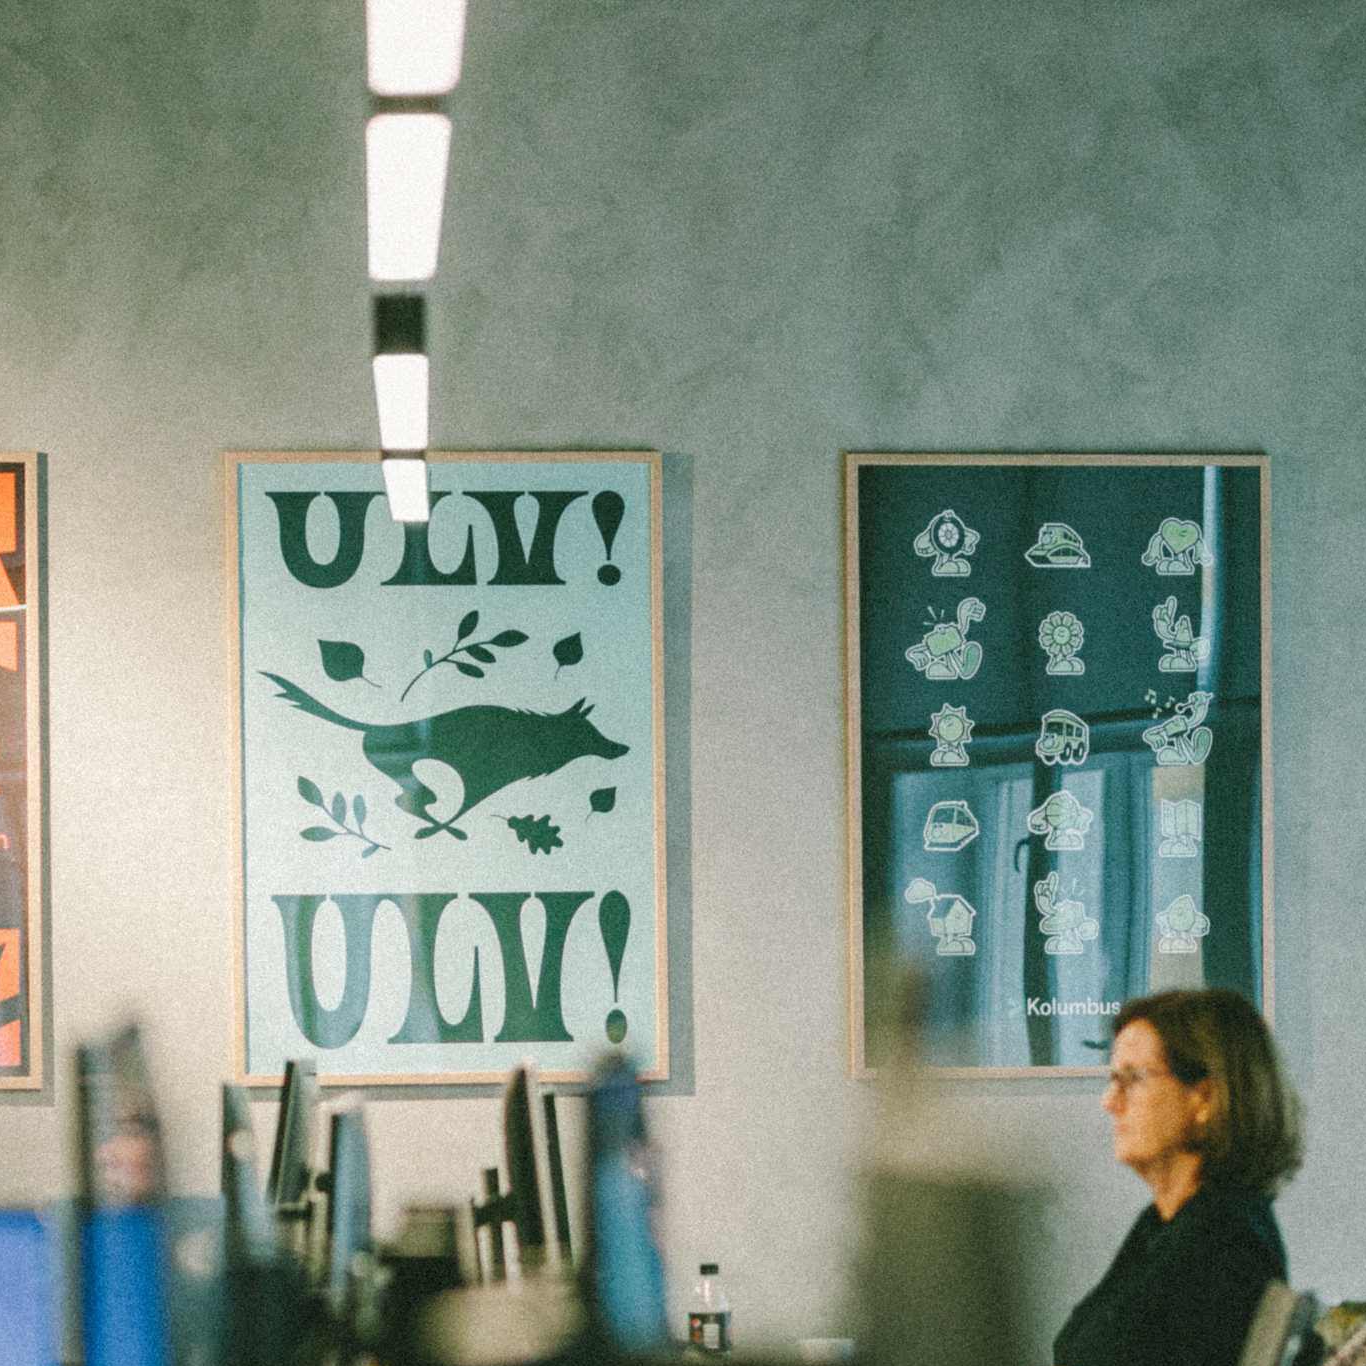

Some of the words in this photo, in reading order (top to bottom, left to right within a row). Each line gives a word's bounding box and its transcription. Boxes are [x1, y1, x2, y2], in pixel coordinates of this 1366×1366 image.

[265, 490, 626, 588] ULV!
[270, 890, 632, 1050] ULV!
[1026, 998, 1121, 1016] Kolumbus
